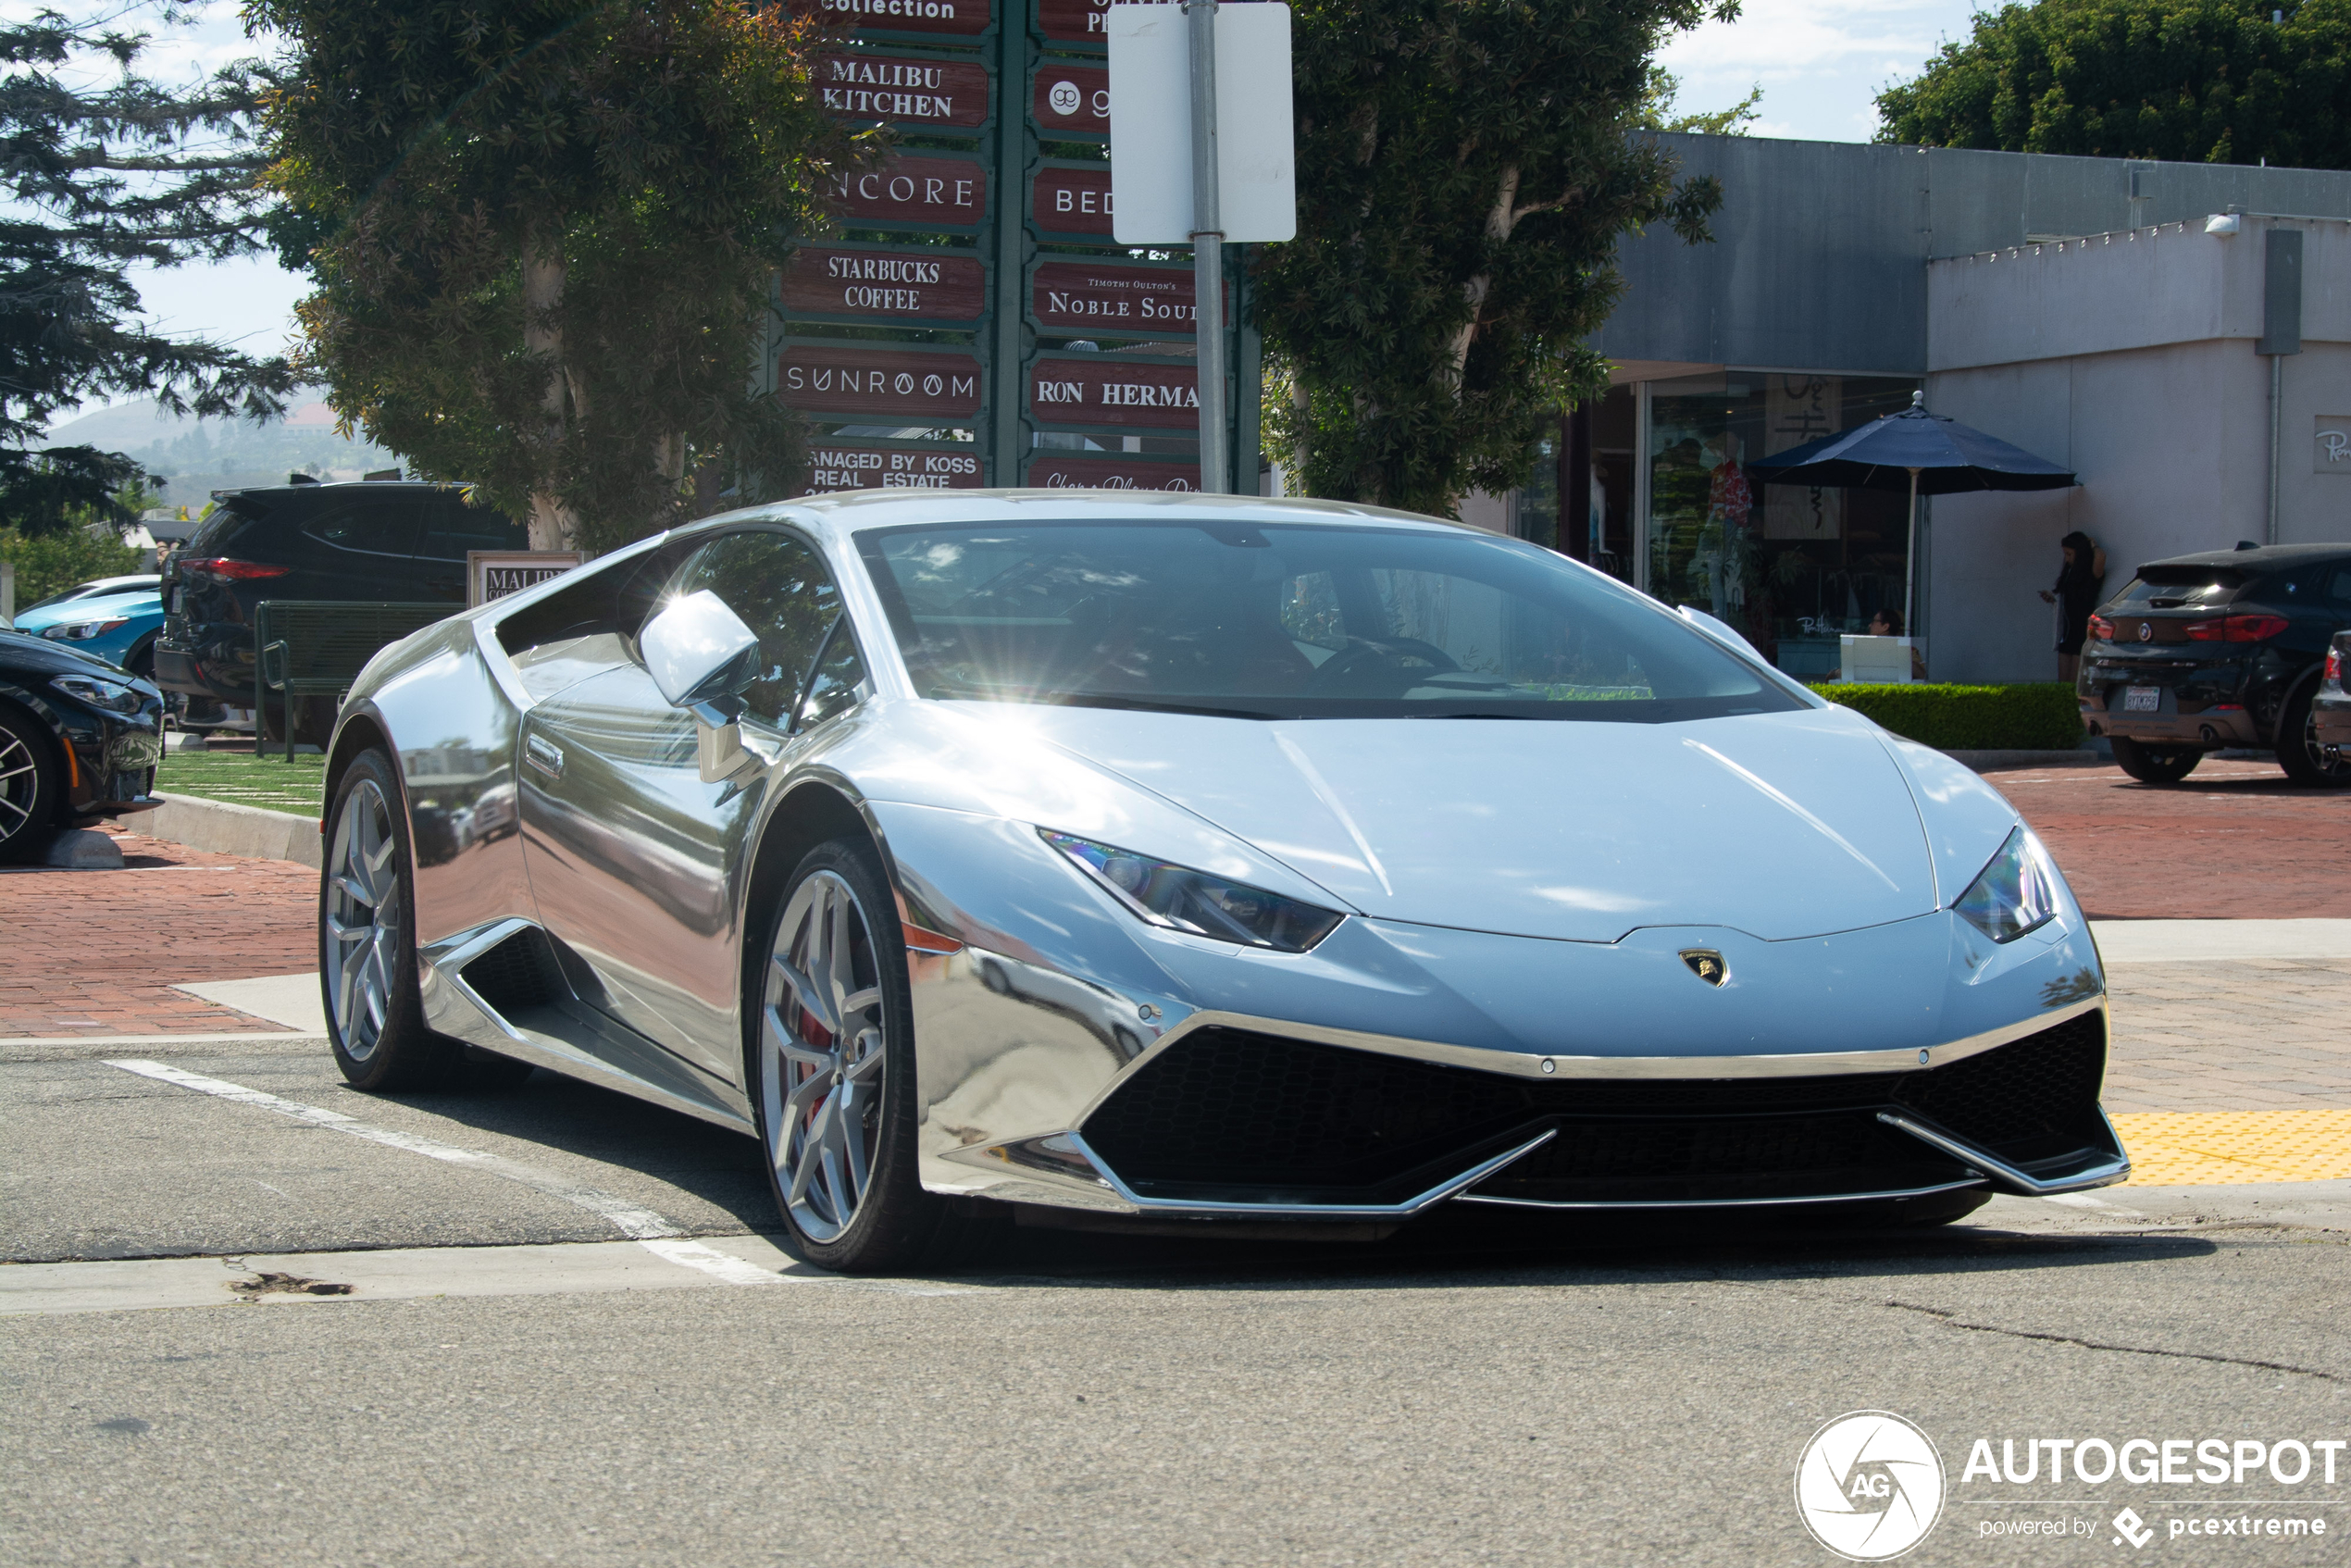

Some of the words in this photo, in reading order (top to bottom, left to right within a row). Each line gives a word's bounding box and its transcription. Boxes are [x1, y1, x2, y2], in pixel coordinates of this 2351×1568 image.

[831, 60, 942, 90] MALIBU
[823, 88, 952, 118] KITCHEN
[828, 256, 940, 283] STARBUCKS
[1088, 279, 1130, 288] TIMOTHY
[844, 286, 920, 310] COFFEE
[1048, 292, 1130, 317] NOBLE
[1037, 381, 1085, 404] RON
[1101, 383, 1200, 408] HERMA
[890, 454, 915, 471] BY
[926, 456, 977, 474] KOSS
[814, 469, 865, 487] REAL
[882, 472, 950, 489] ESTATE
[489, 570, 564, 588] MALI
